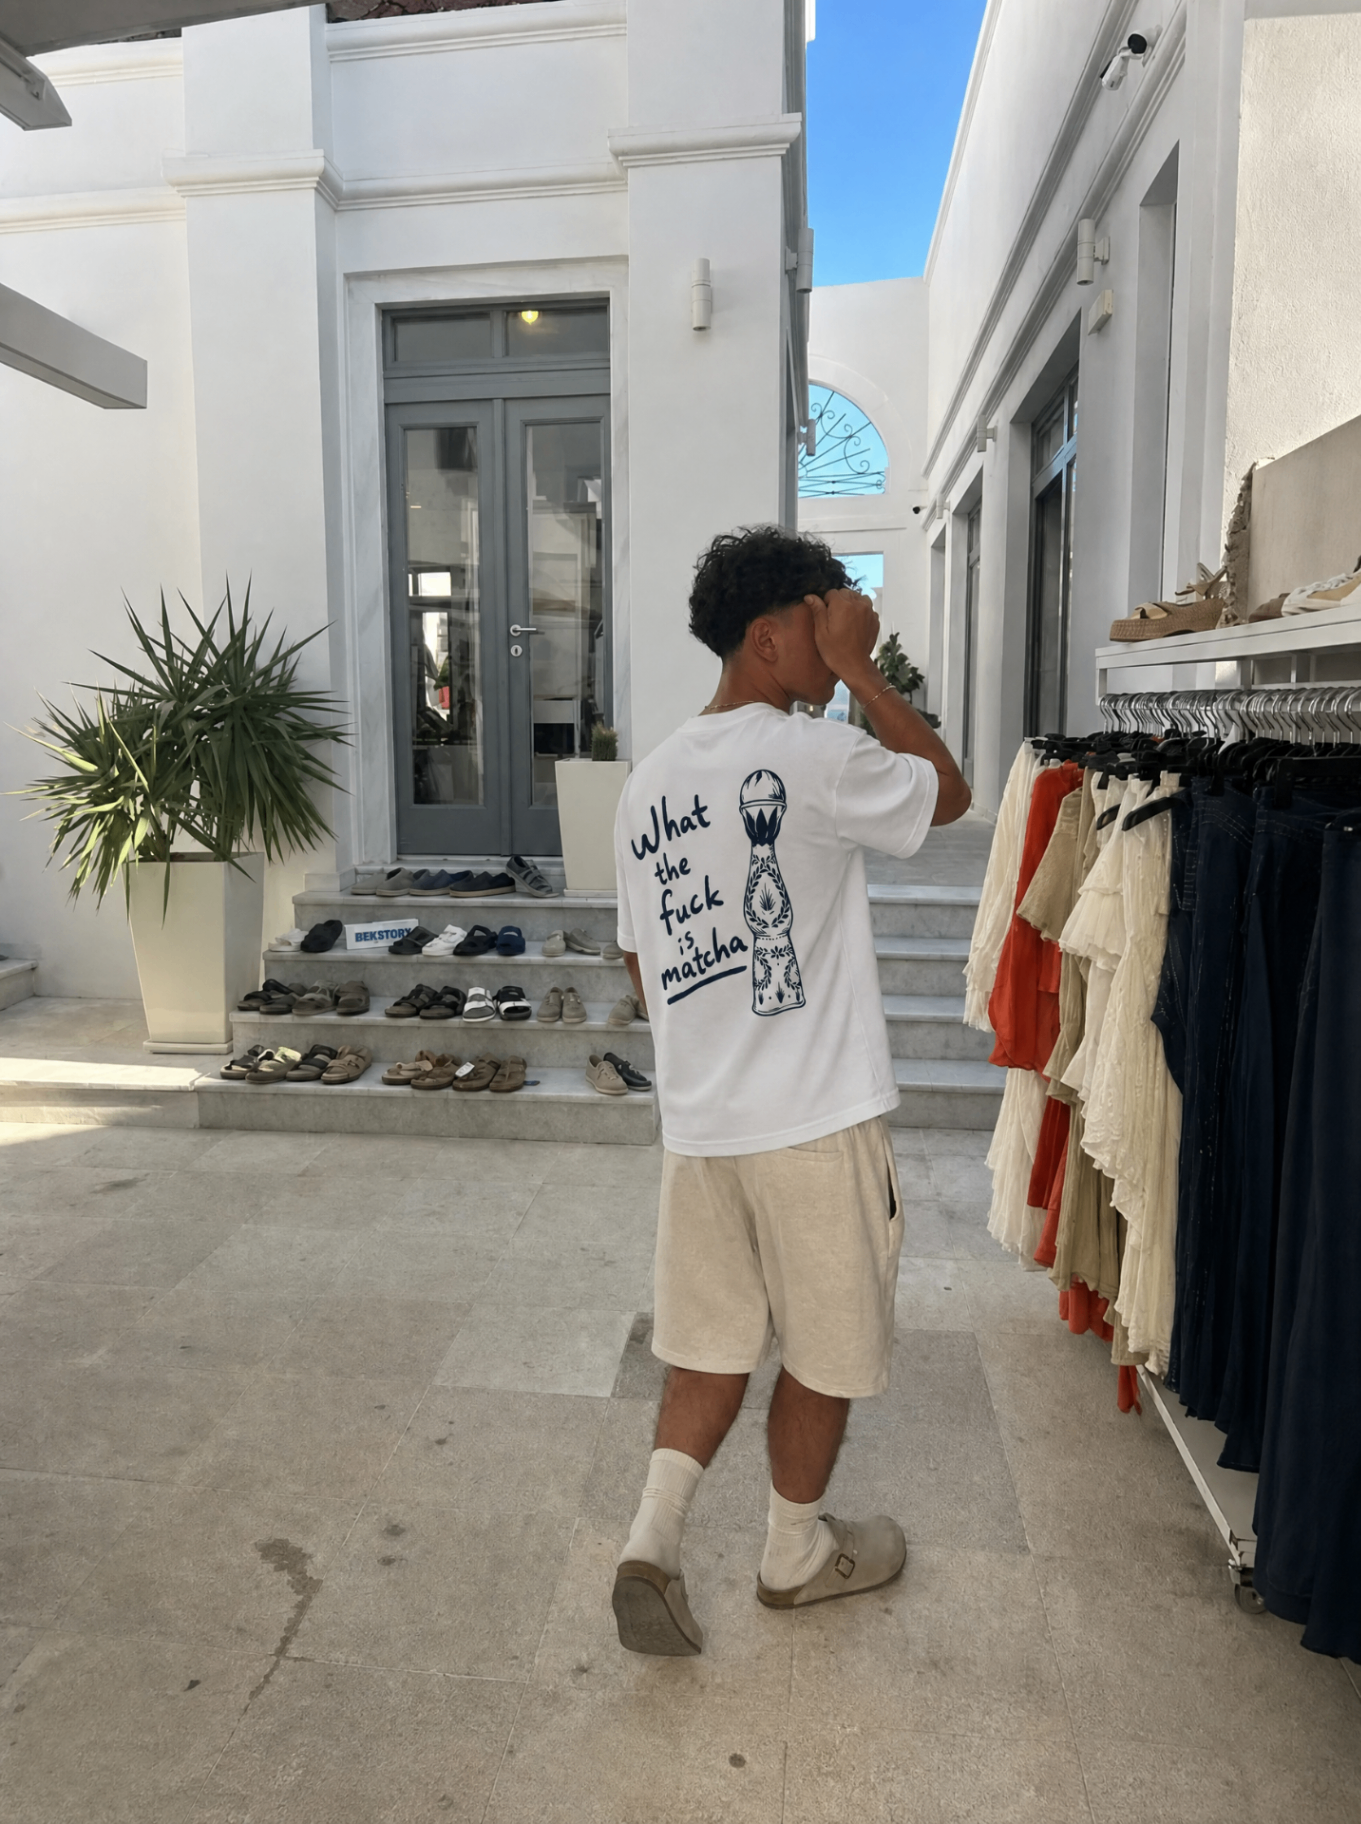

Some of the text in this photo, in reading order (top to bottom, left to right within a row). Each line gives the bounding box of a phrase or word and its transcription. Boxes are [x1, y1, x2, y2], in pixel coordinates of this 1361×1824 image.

[631, 794, 711, 861] What
[654, 852, 691, 886] the
[659, 874, 724, 936] fuck
[661, 926, 749, 991] matcha
[677, 930, 695, 956] is
